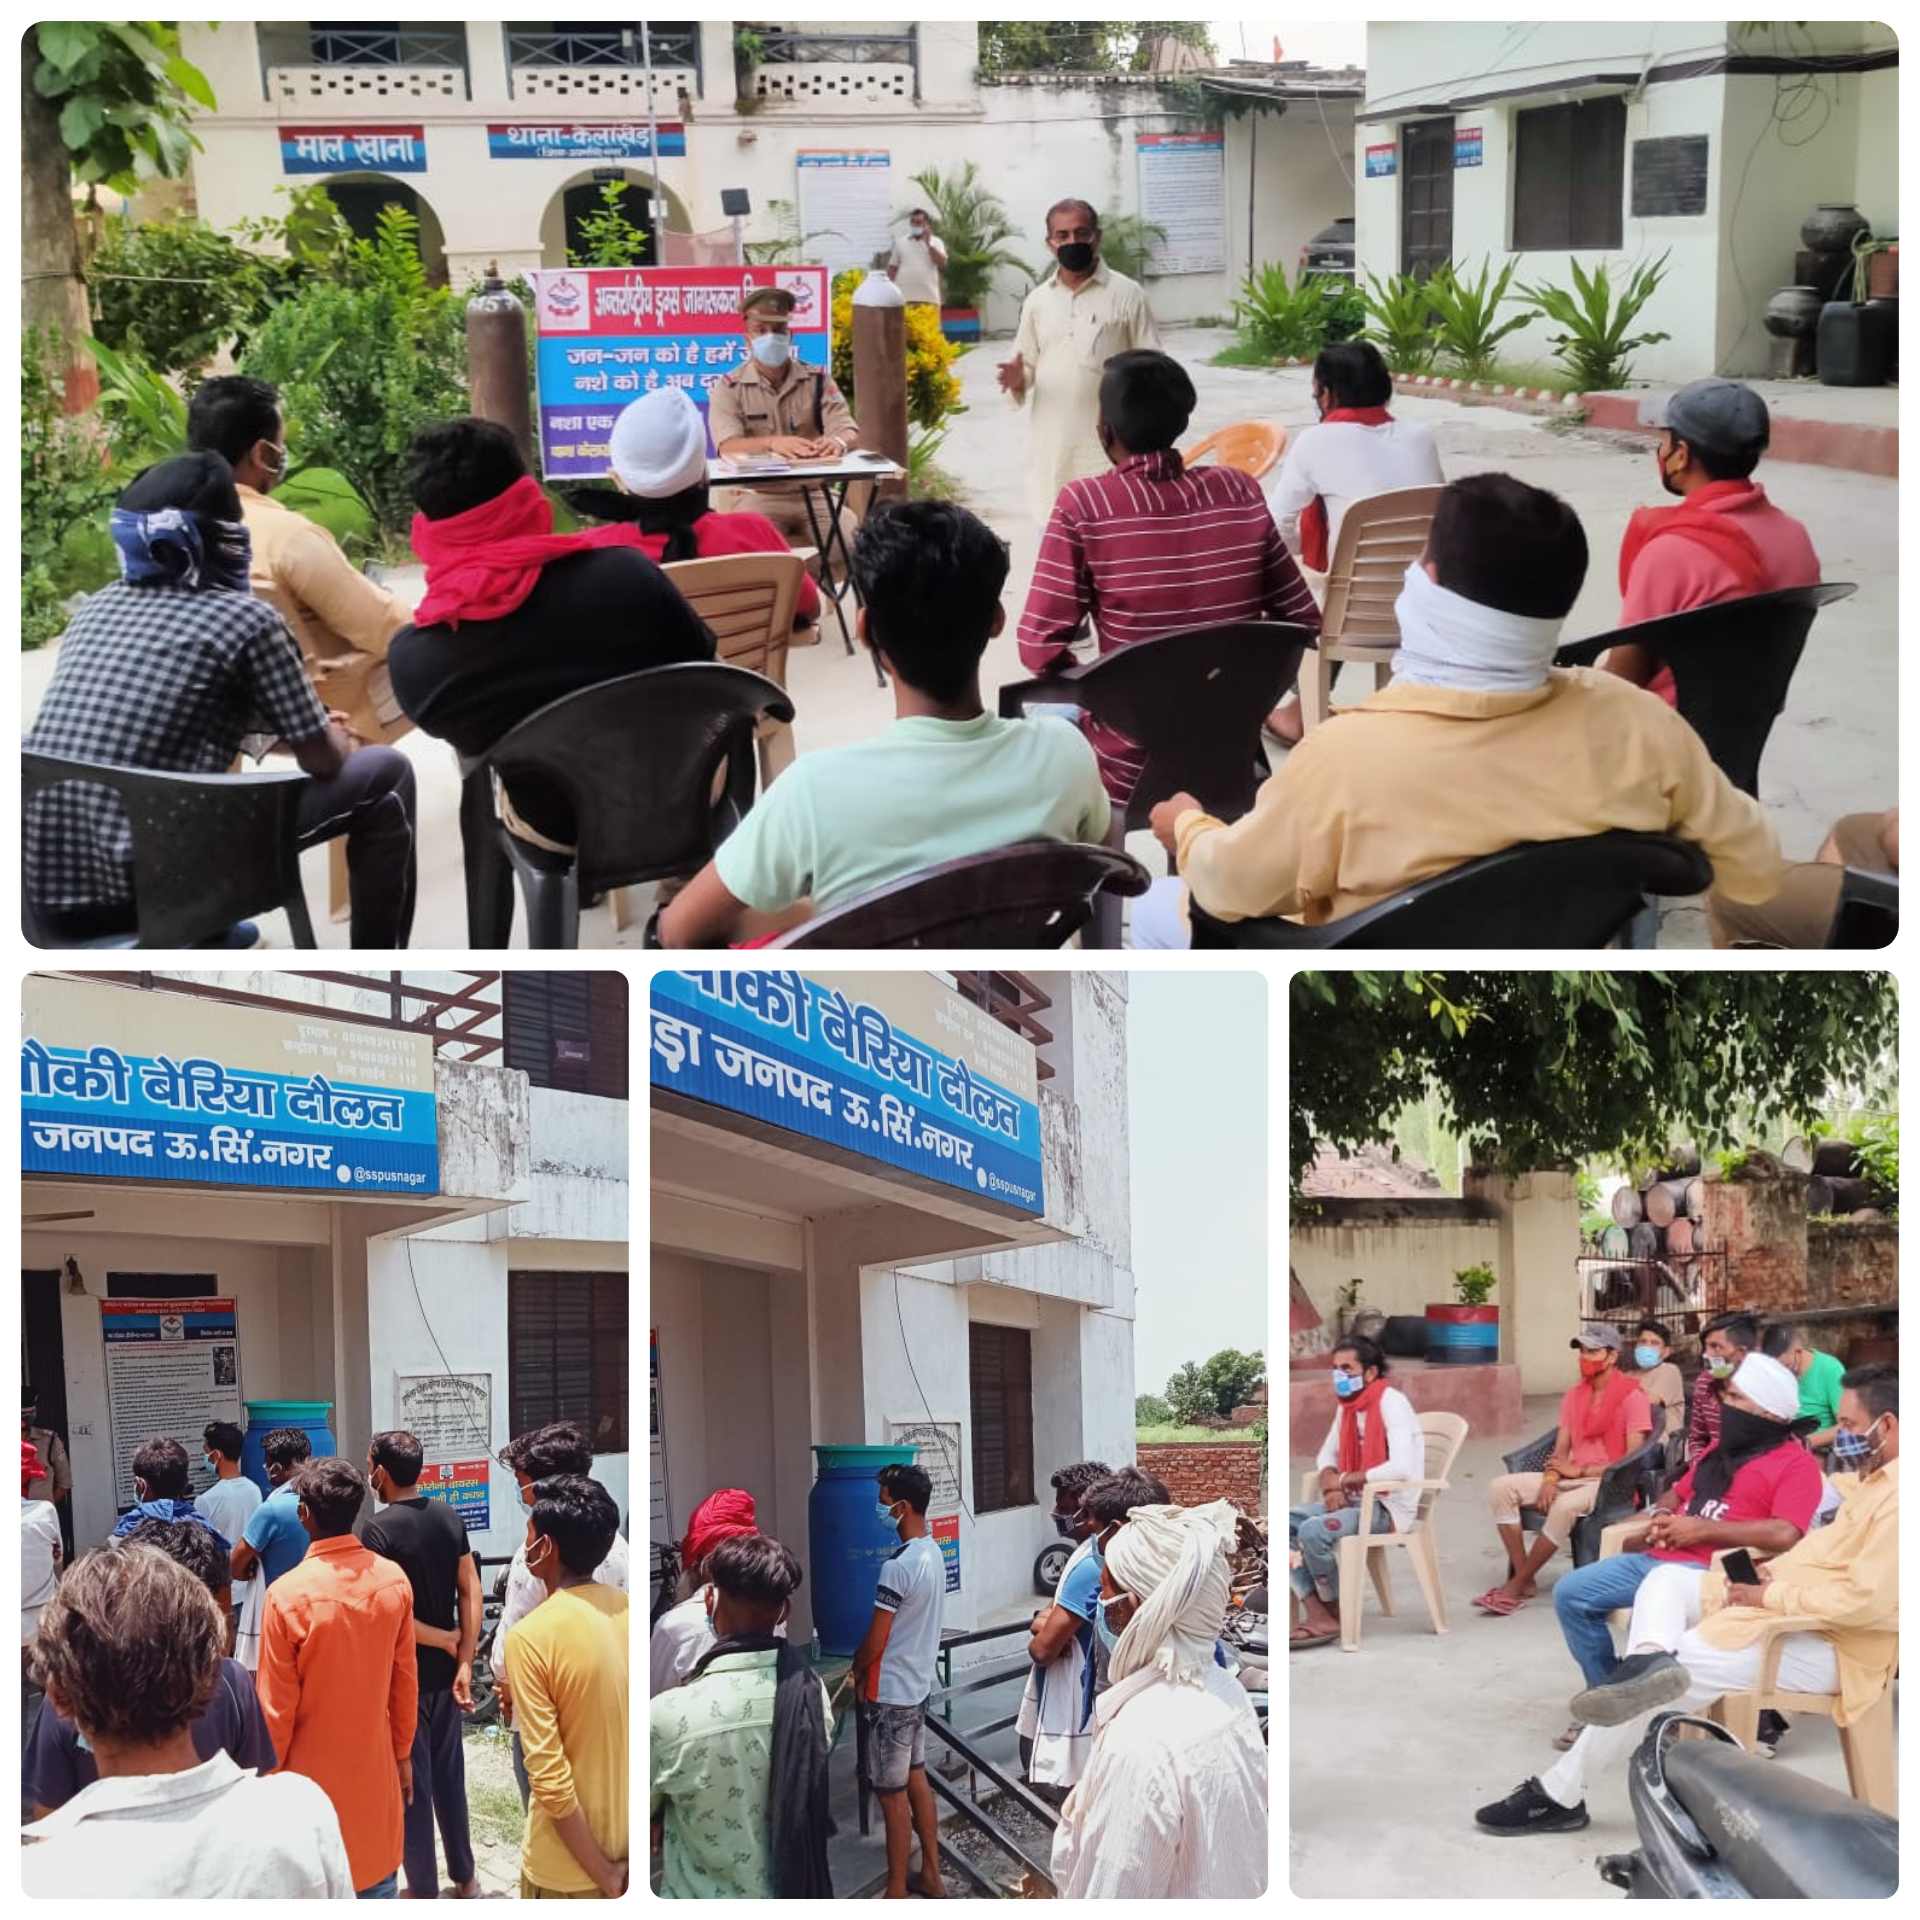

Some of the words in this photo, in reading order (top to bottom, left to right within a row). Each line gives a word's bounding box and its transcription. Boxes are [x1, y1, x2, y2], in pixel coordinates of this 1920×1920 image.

[294, 134, 346, 163] माल
[351, 134, 415, 164] खाना
[566, 348, 649, 365] जन-जन
[654, 341, 680, 363] को
[684, 340, 699, 364] है
[704, 341, 736, 364] हमें
[572, 369, 608, 391] नशे
[612, 369, 639, 390] को
[643, 368, 660, 391] है
[665, 373, 694, 390] अब
[549, 416, 582, 431] नशा
[586, 416, 614, 431] एक
[710, 1033, 834, 1116] जनपद
[818, 988, 933, 1099] बेरिया
[938, 1056, 1020, 1141] दौलत
[140, 1053, 278, 1119] बेरिया
[284, 1071, 405, 1131] दौलत
[28, 1121, 156, 1157] जनपद
[354, 1166, 426, 1186] @sspusnagar
[988, 1173, 1037, 1204] @sspusnagar
[449, 1478, 479, 1490] वायरस
